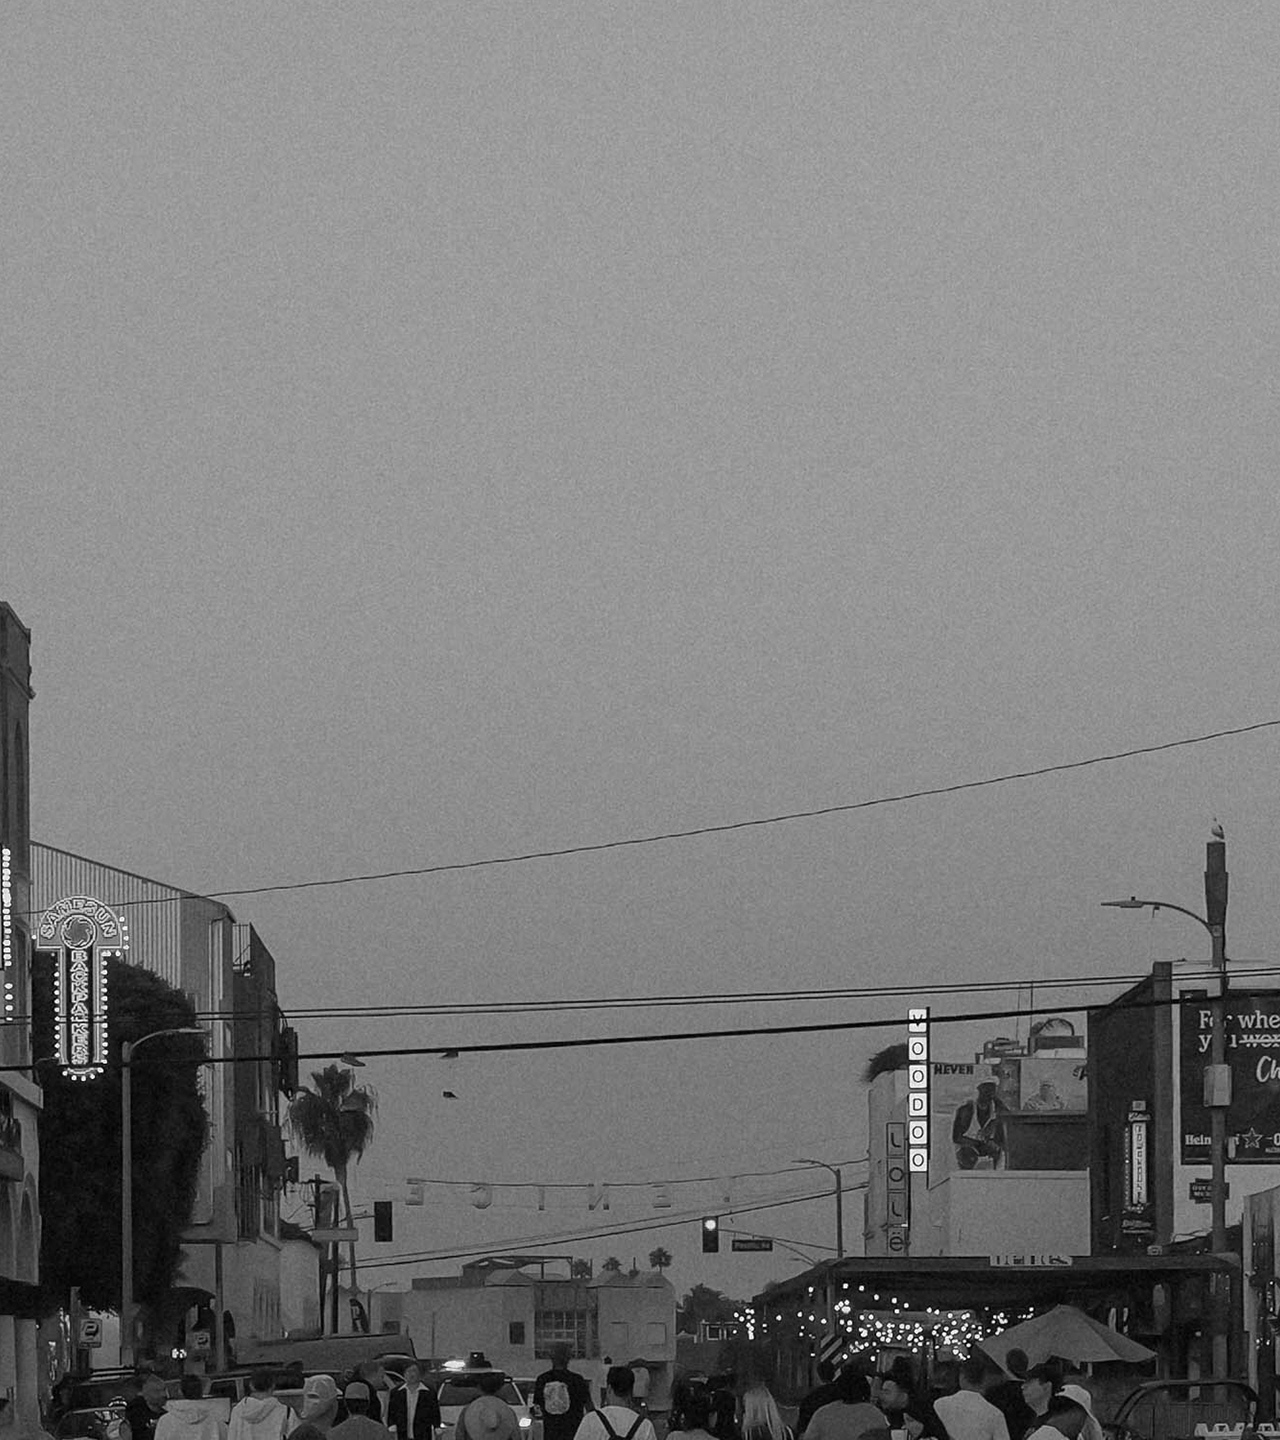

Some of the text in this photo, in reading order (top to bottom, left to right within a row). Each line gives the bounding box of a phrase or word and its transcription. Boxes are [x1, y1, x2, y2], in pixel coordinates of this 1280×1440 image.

[41, 899, 117, 939] SAMESUN
[1198, 1033, 1238, 1052] yu
[911, 1013, 926, 1168] VOODOO
[1184, 1133, 1240, 1146] Heinn
